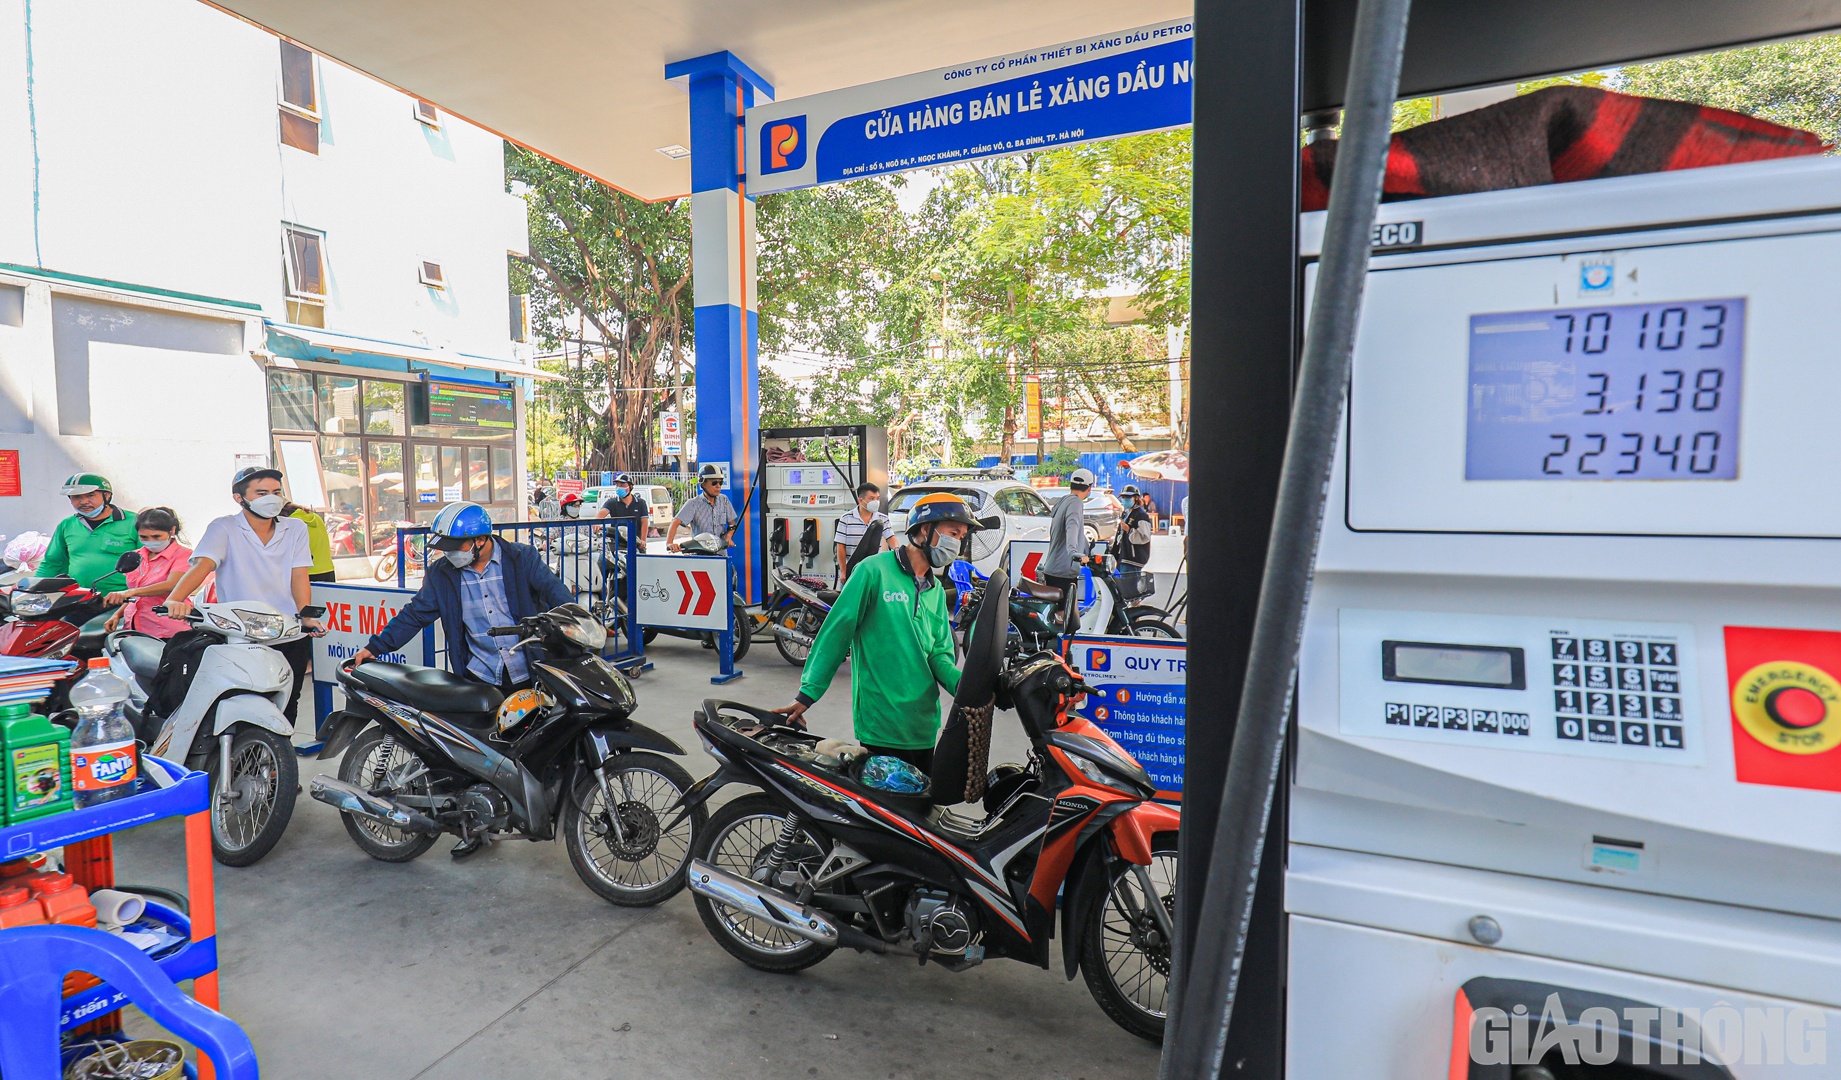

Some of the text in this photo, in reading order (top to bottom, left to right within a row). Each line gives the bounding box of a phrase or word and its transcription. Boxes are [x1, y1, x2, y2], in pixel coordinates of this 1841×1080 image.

[944, 68, 972, 81] CÔNG
[975, 65, 988, 75] TY
[991, 58, 1005, 71] CỔ
[1040, 45, 1073, 61] THIẾT
[1075, 45, 1087, 55] BỊ
[1090, 37, 1122, 51] XĂNG
[1152, 22, 1194, 39] PETRO
[865, 60, 1194, 140] CỬA HÀNG BÁN LẺ XĂNG DẦU N
[918, 154, 936, 164] NGỌC
[963, 148, 970, 156] P.
[1006, 141, 1013, 149] Q.
[1015, 139, 1025, 147] BA
[1046, 134, 1058, 142] TP.
[1059, 130, 1070, 139] HÀ
[1071, 128, 1085, 138] NỘI
[1554, 304, 1727, 354] 70103
[1582, 368, 1724, 415] 3.138
[1541, 431, 1721, 475] 22340
[883, 590, 910, 603] Grab
[325, 602, 352, 633] XE
[328, 642, 346, 659] MỜI
[1556, 639, 1673, 663] 7 8 9 X
[1124, 656, 1161, 671] QUY
[1558, 664, 1576, 681] 4
[1590, 666, 1606, 682] 5
[1623, 668, 1641, 684] 6
[1746, 669, 1837, 704] EMERGENCY
[1119, 690, 1126, 702] 1
[1135, 691, 1162, 706] Hướng
[1163, 692, 1177, 704] dẫn
[1561, 691, 1574, 707] 1
[1592, 693, 1608, 710] 2
[1624, 695, 1641, 711] 3
[1097, 707, 1106, 719] 2
[1113, 709, 1136, 723] Thông
[1136, 712, 1150, 723] báo
[1151, 714, 1173, 725] khách
[1386, 704, 1529, 730] P1 P2 P3 P4 000
[1123, 730, 1144, 743] hàng
[1145, 733, 1156, 743] đủ
[1157, 734, 1176, 745] theo
[1563, 720, 1579, 737] 0
[1627, 725, 1643, 743] C
[1778, 731, 1823, 746] STOP
[1137, 750, 1159, 762] khách
[1159, 753, 1178, 766] hàng
[1160, 774, 1171, 783] ơn
[1059, 800, 1089, 810] HONDA
[72, 996, 109, 1020] tiến
